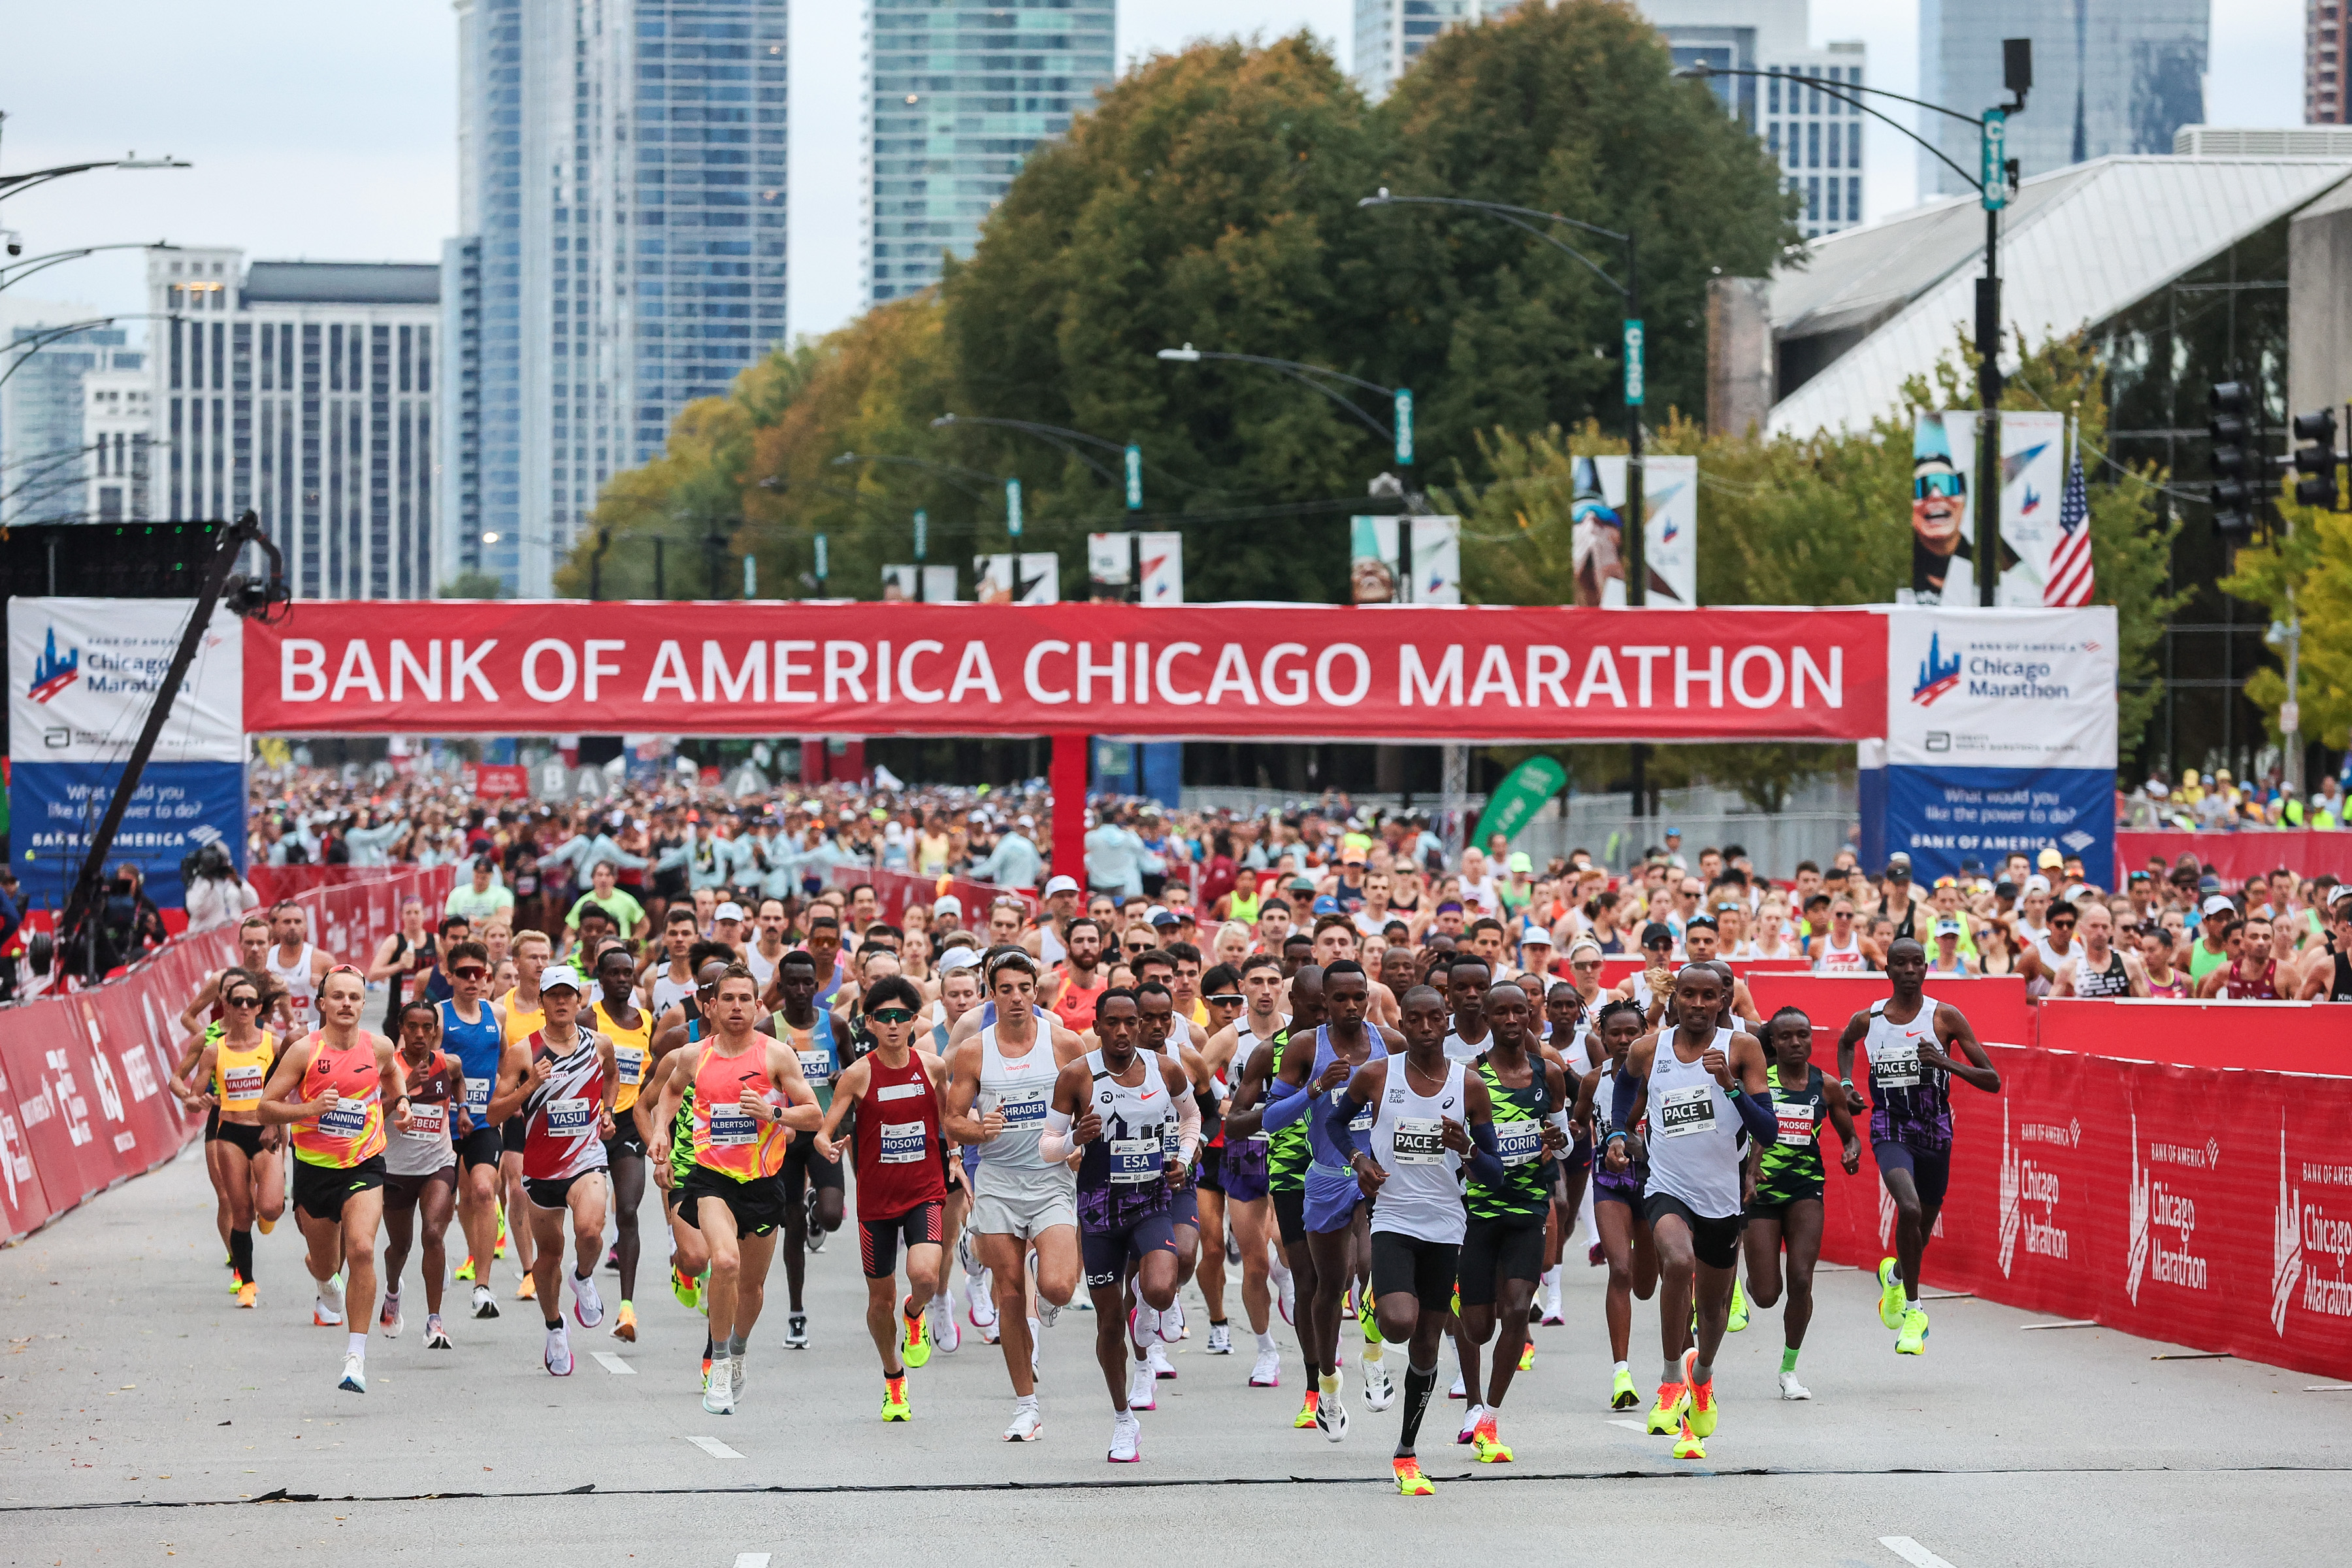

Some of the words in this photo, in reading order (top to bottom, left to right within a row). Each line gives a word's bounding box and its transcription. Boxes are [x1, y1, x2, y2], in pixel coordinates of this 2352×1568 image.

[1985, 120, 2003, 201] C110
[280, 638, 500, 702] BANK
[521, 638, 626, 702] OF
[642, 640, 1002, 704] AMERICA
[1023, 640, 1371, 707] CHICAGO
[1399, 644, 1843, 709] MARATHON
[1970, 657, 2051, 681] Chicago
[1970, 681, 2069, 699] Marathon
[157, 785, 185, 804] you
[1944, 789, 1983, 803] What
[1986, 789, 2029, 804] would
[2032, 792, 2060, 809] you
[1925, 805, 1951, 821] like
[1953, 807, 1978, 823] the
[1980, 808, 2025, 826] power
[2029, 808, 2046, 823] to
[32, 832, 78, 847] BANK
[1910, 833, 1955, 849] BANK
[1958, 834, 1980, 849] OF
[1982, 836, 2059, 851] AMERICA
[802, 1064, 828, 1075] ASAI
[1877, 1062, 1906, 1074] PACE
[1909, 1060, 1918, 1071] 6
[226, 1078, 261, 1089] VAUGHN
[551, 1111, 586, 1124] YASUI
[1001, 1103, 1045, 1117] SHRADER
[1664, 1103, 1699, 1121] PACE
[1703, 1102, 1710, 1114] 1
[711, 1120, 755, 1129] ALBERTSON
[1778, 1120, 1812, 1130] PKOSGEI
[882, 1137, 924, 1149] HOSOYA
[1396, 1134, 1433, 1149] PACE
[1436, 1137, 1445, 1149] 2
[1498, 1135, 1537, 1152] KORIR
[2021, 1123, 2036, 1141] BANK
[2037, 1124, 2045, 1141] OF
[2045, 1125, 2070, 1147] AMERICA
[1123, 1155, 1150, 1168] ESA
[2151, 1142, 2167, 1162] BANK
[2168, 1144, 2176, 1164] OF
[2178, 1146, 2206, 1168] AMERICA
[2302, 1162, 2321, 1184] BANK
[2323, 1164, 2332, 1184] OF
[2021, 1159, 2059, 1215] Chicago
[2153, 1181, 2195, 1243] Chicago
[2304, 1203, 2352, 1269] Chicago
[2152, 1237, 2207, 1290] Marathon
